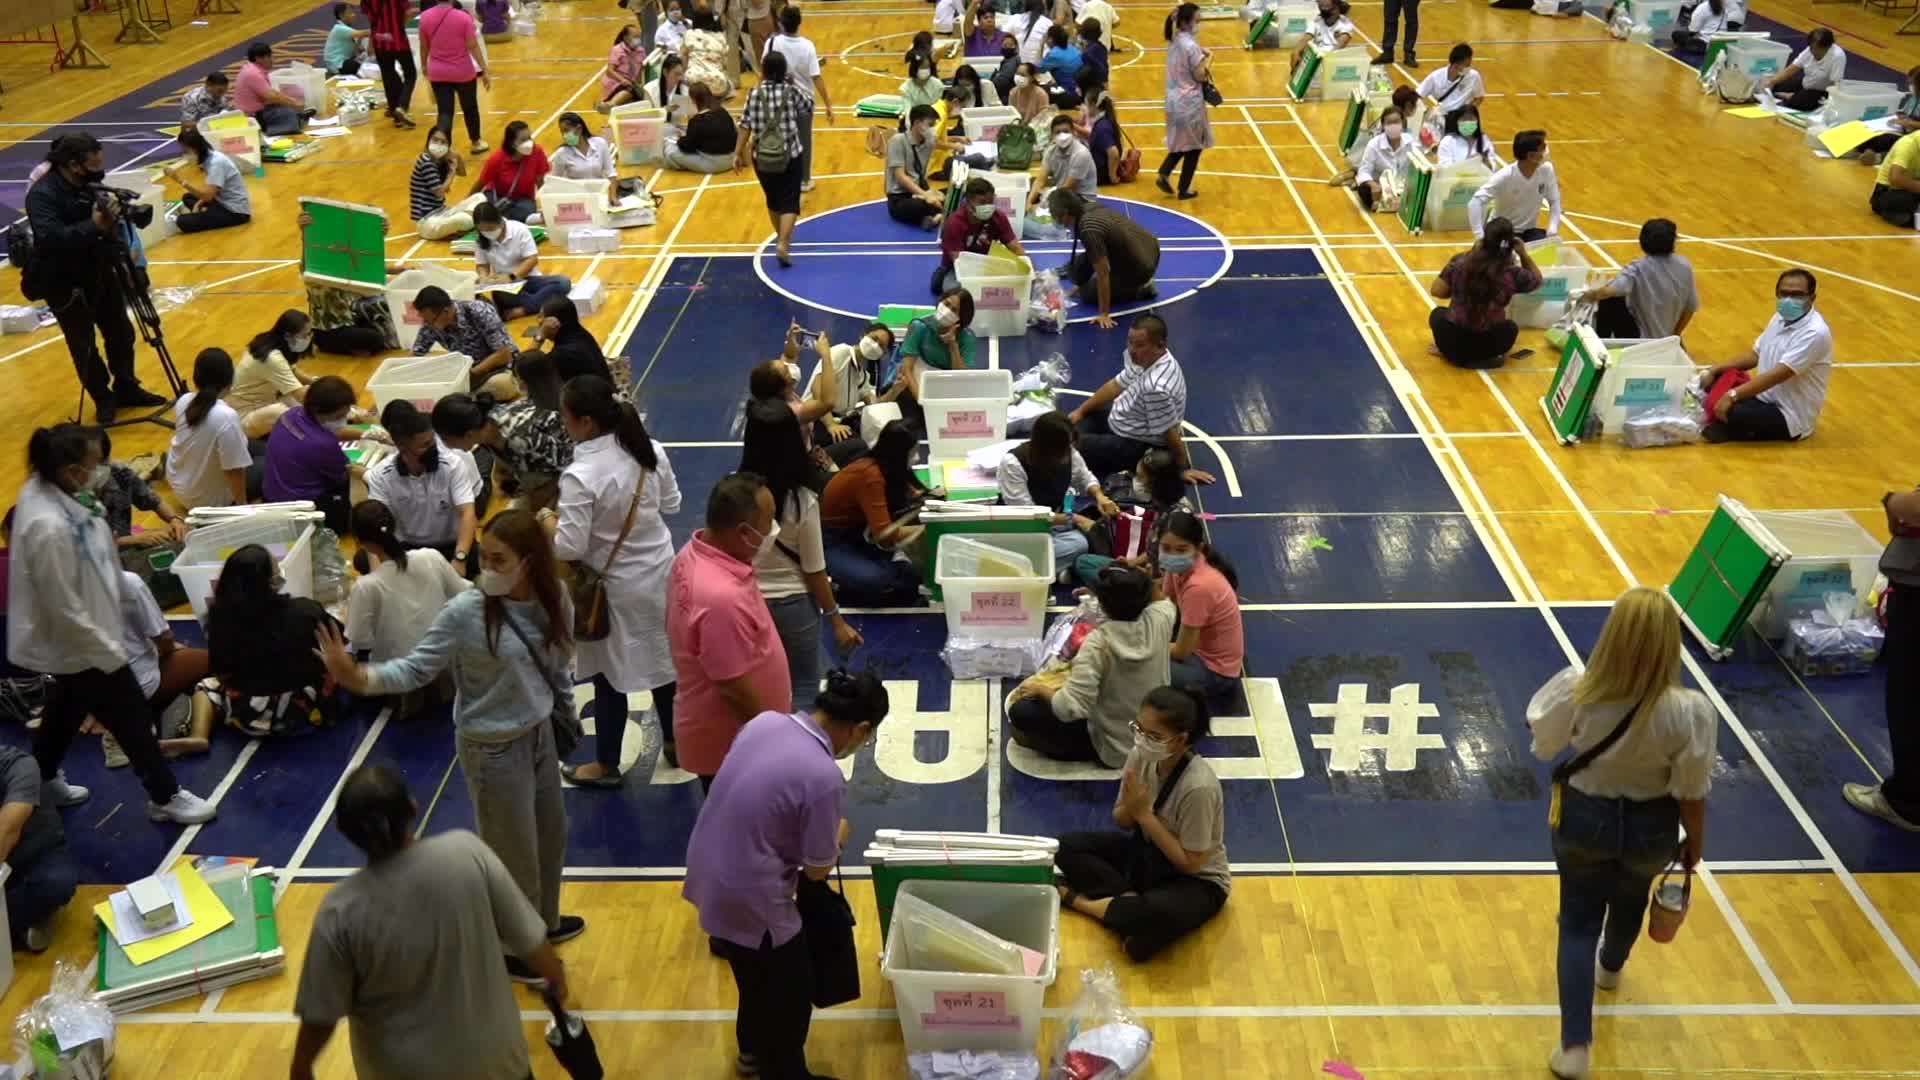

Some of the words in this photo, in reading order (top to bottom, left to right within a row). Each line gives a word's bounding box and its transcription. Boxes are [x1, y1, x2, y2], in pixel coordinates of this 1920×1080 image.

[976, 593, 1000, 609] ชุดที่
[943, 991, 973, 1011] ชุดที่
[978, 997, 994, 1009] 21
